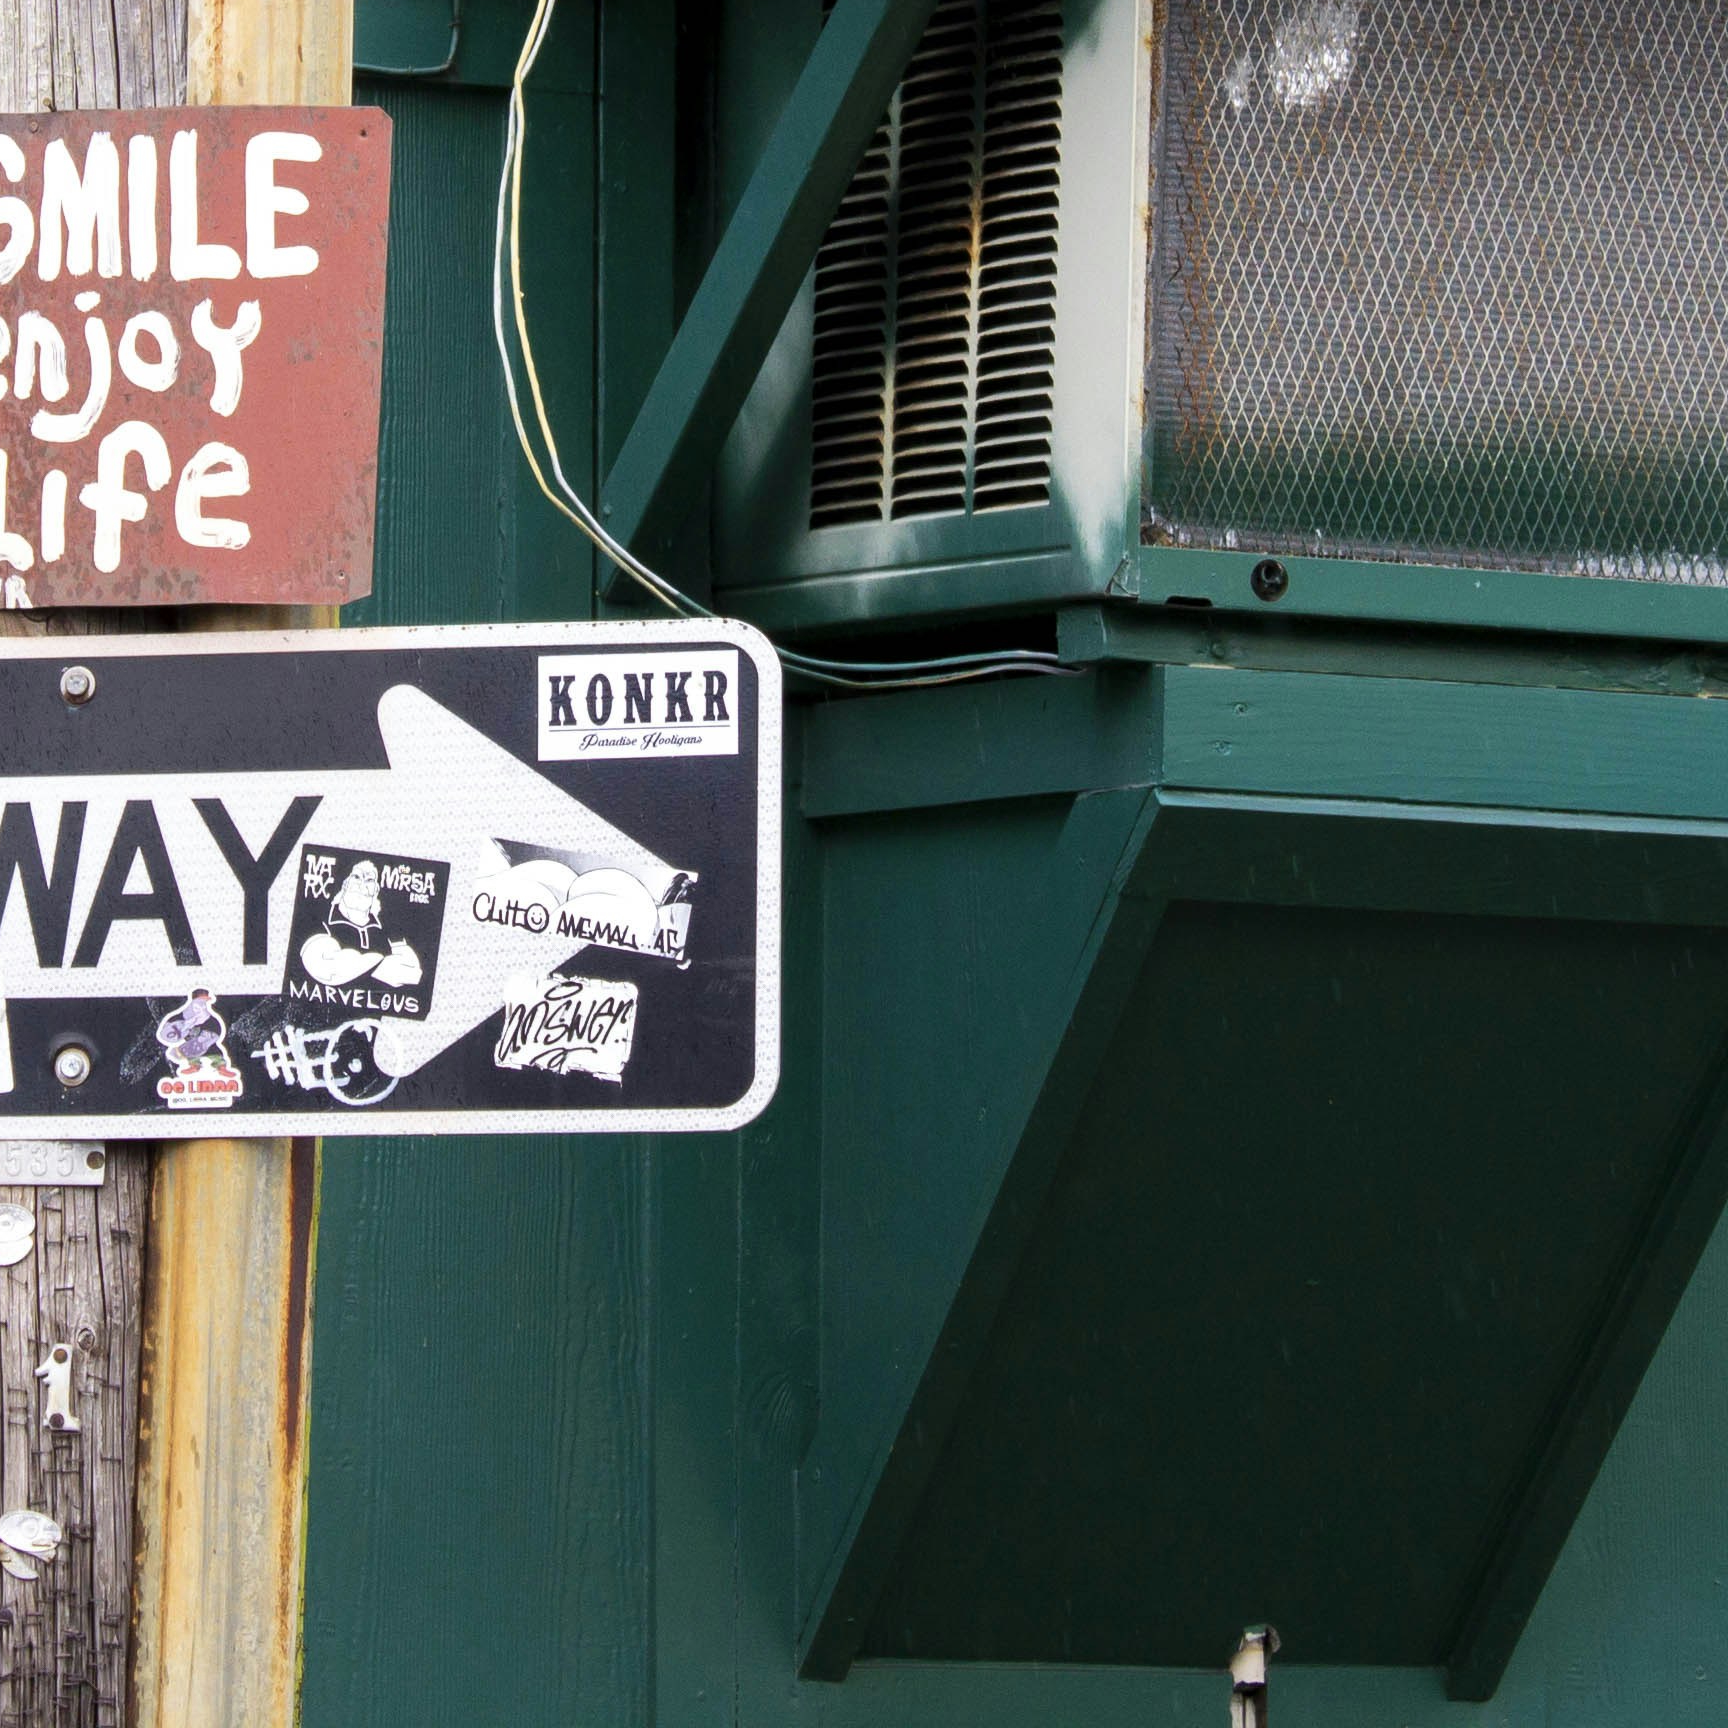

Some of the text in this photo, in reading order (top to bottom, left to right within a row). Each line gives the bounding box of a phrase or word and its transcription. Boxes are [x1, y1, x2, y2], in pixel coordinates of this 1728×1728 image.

[548, 670, 730, 727] KONKR
[579, 732, 702, 751] Paradise Hooligans
[381, 864, 435, 896] MRSA
[289, 980, 419, 1013] MARVELOUS
[34, 1342, 82, 1432] 1
